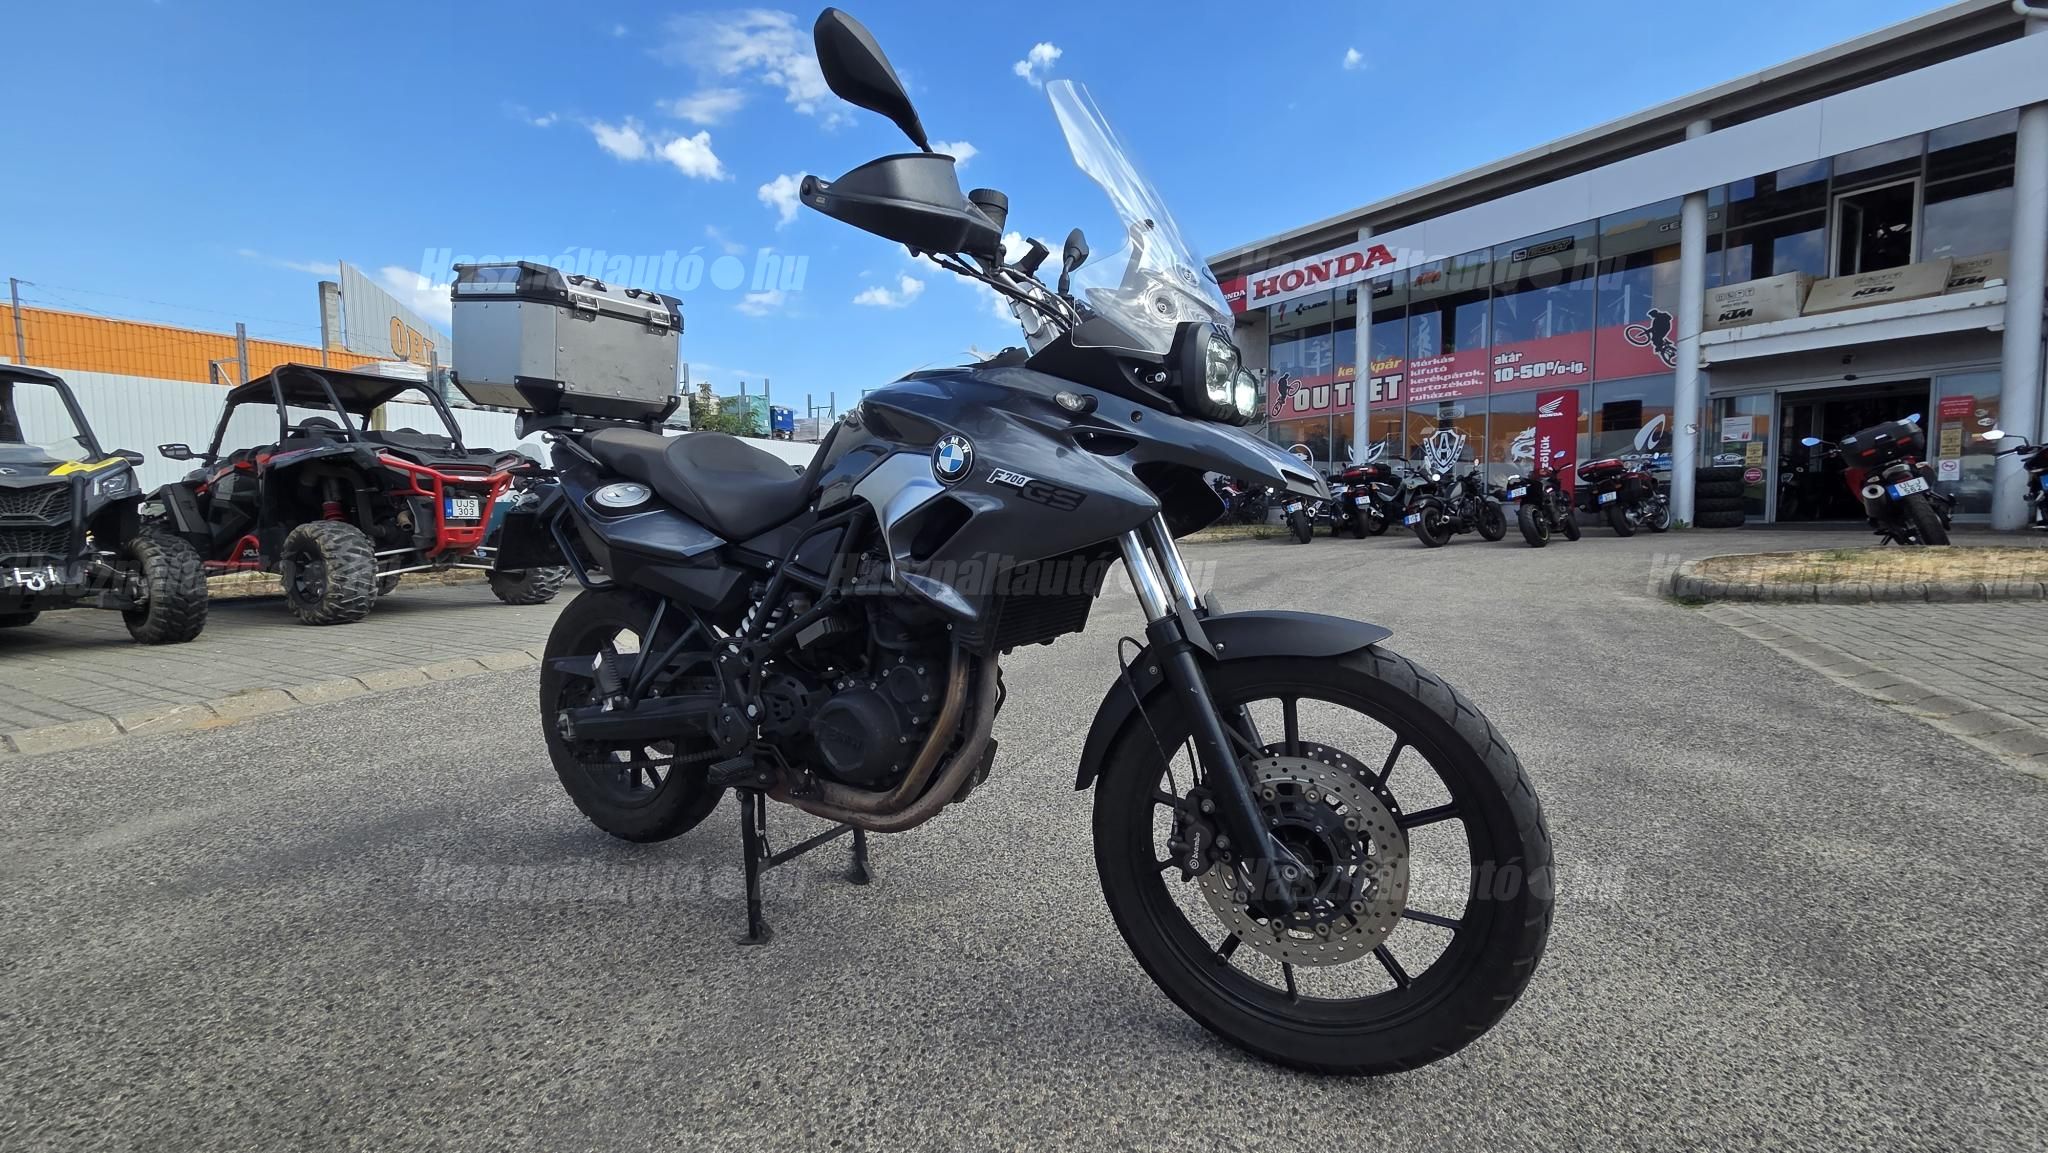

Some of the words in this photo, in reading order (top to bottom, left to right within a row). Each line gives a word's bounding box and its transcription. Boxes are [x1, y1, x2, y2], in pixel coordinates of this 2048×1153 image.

[1253, 244, 1397, 300] HONDA
[1223, 290, 1246, 300] ONDA
[1852, 286, 1895, 297] KTM
[1717, 308, 1753, 321] KTM
[390, 316, 434, 364] OBI
[1411, 356, 1455, 368] Márkás
[1494, 352, 1522, 365] akár
[1338, 359, 1402, 377] kekpár
[1411, 366, 1447, 376] kifutó
[1293, 373, 1403, 412] OUTET
[939, 437, 970, 453] BMW
[1017, 479, 1088, 512] GS
[458, 508, 474, 516] 303
[1192, 832, 1200, 858] brembo
